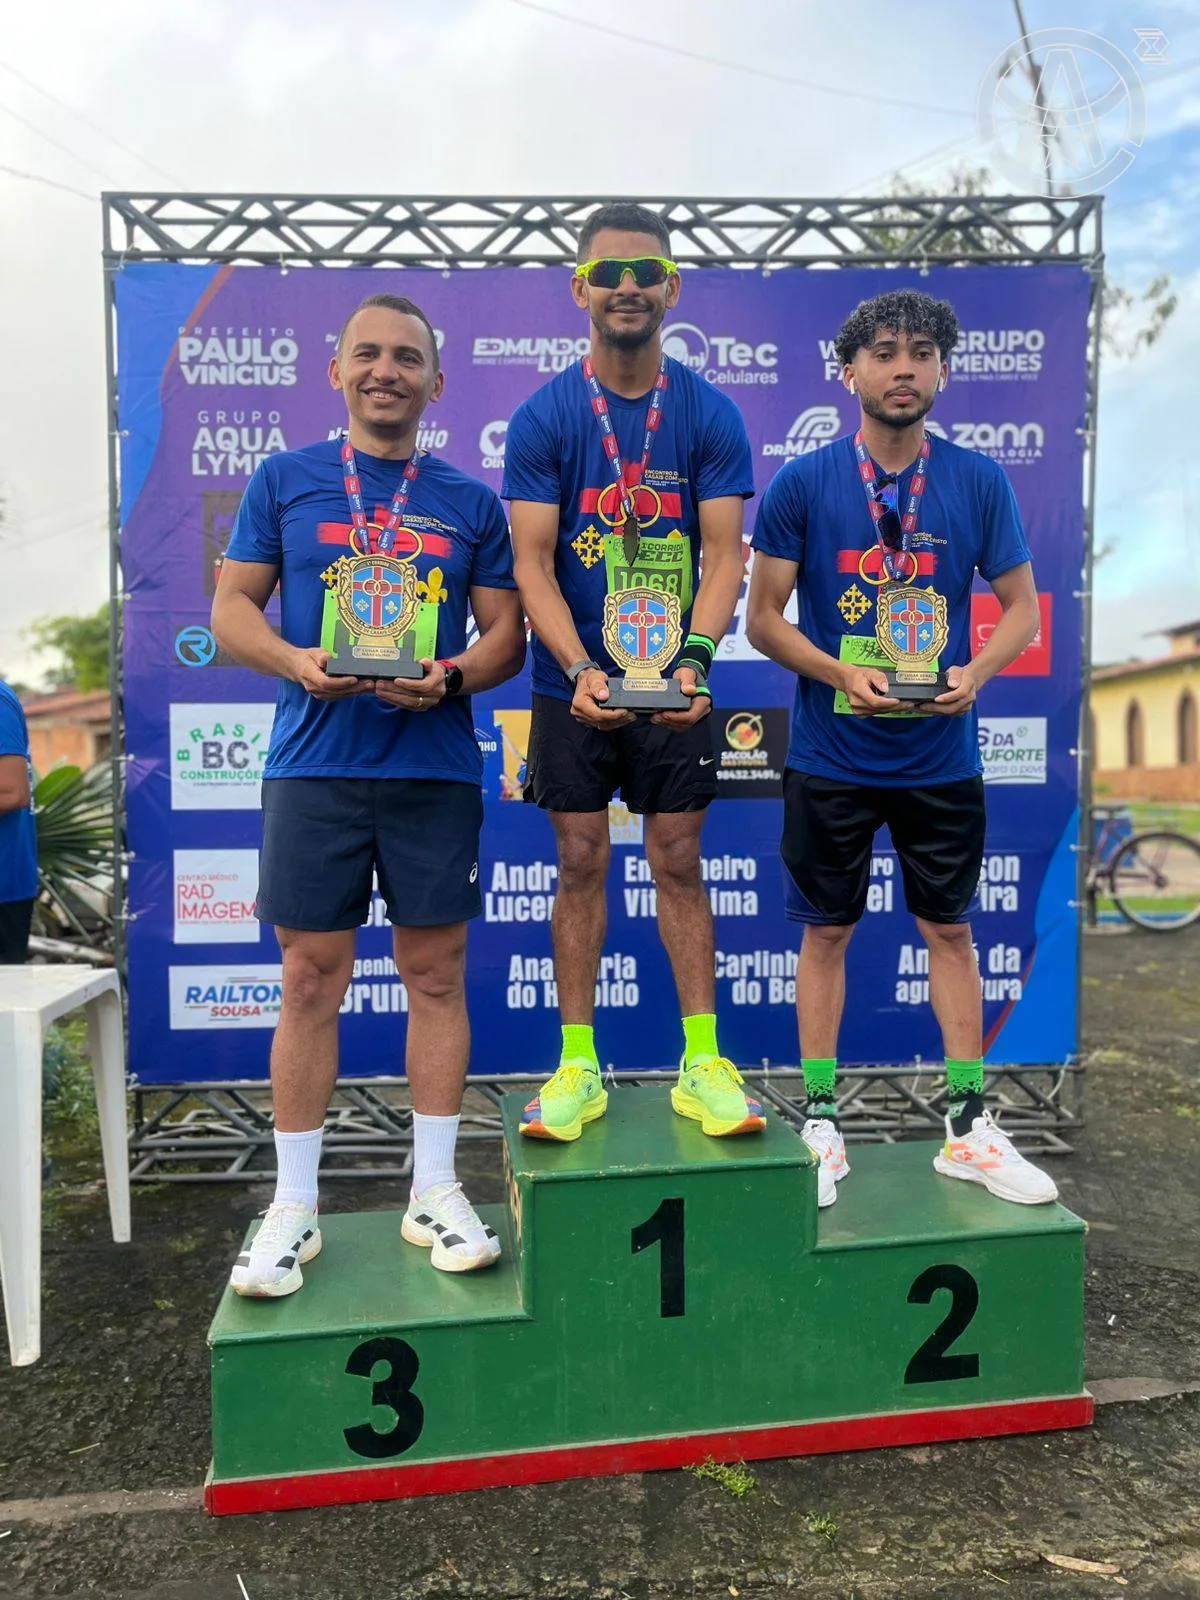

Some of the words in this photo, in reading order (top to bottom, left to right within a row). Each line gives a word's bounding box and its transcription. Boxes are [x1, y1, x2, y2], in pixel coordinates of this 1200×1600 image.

[178, 327, 294, 337] PREFEITO
[950, 329, 1045, 352] GRUPO
[178, 337, 299, 364] PAULO
[472, 337, 592, 356] EDMUNDO
[709, 336, 778, 368] Tec
[950, 353, 1042, 373] MENDES
[704, 369, 779, 385] Celulares
[197, 411, 281, 424] GRUPO
[193, 426, 287, 455] AQUA
[951, 422, 1045, 449] zann
[978, 449, 1043, 459] OLOGIA
[620, 571, 679, 596] 1068
[176, 723, 269, 762] BRASIL
[992, 733, 1015, 747] DA
[201, 740, 250, 770] BC
[721, 749, 768, 761] SACOLÃO
[980, 748, 1045, 762] UFORTE
[180, 769, 263, 781] CONSTRUÇÕE
[177, 874, 207, 883] CENTRO
[491, 861, 558, 892] Andr
[177, 883, 215, 900] RAD
[624, 888, 657, 918] Vit
[710, 887, 758, 916] ima
[509, 955, 553, 981] Ana
[714, 950, 801, 978] Carlinh
[988, 944, 1020, 973] da
[507, 981, 537, 1009] do
[732, 978, 763, 1005] do
[210, 1005, 261, 1018] SOUSA
[631, 1198, 685, 1318] 1
[904, 1264, 981, 1385] 2
[343, 1336, 425, 1459] 3
